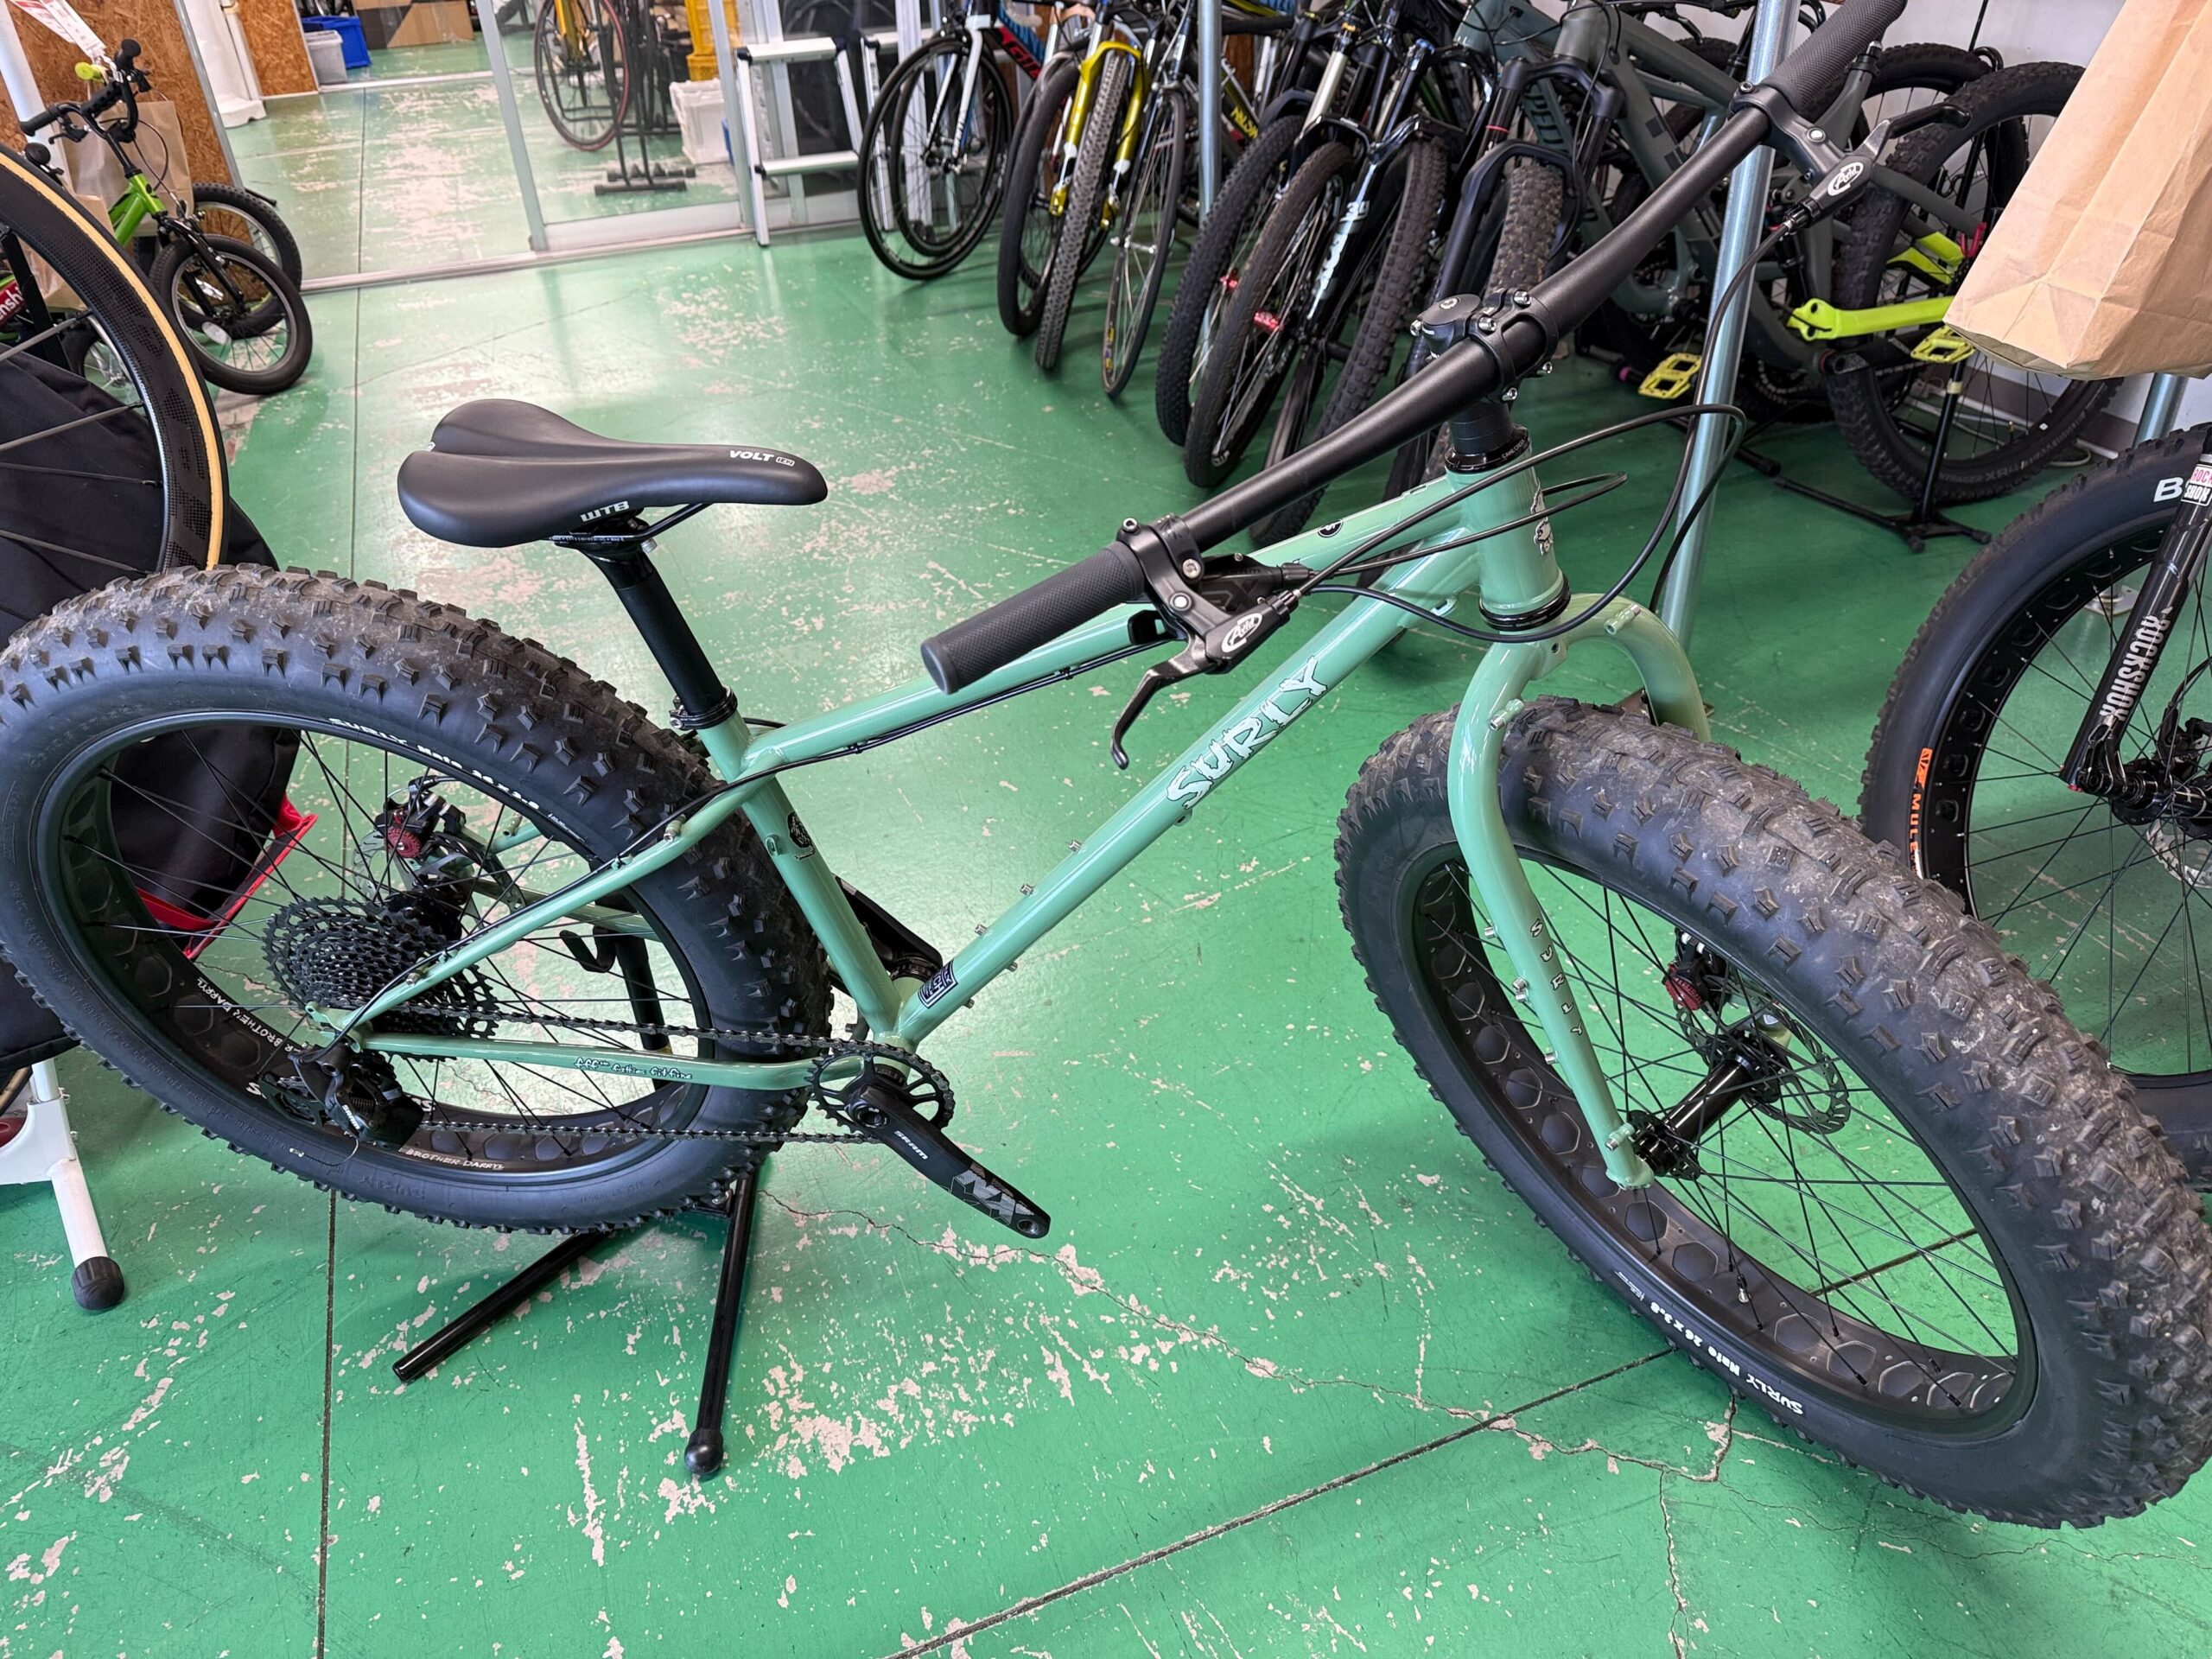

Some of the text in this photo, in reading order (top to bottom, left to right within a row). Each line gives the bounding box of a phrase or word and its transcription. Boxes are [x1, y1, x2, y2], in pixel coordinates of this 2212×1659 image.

[729, 450, 775, 462] VOLT
[2183, 484, 2211, 502] SHOX
[580, 501, 630, 522] WTB
[2099, 614, 2171, 721] ROCKSHOX
[328, 718, 407, 745] SURLY
[1166, 655, 1328, 810] SURLY
[1529, 918, 1583, 1036] SURLY
[893, 1130, 928, 1160] SRAM
[463, 1160, 505, 1171] DARRYL
[1707, 1345, 1740, 1376] Nate
[1746, 1374, 1803, 1414] SURLY
